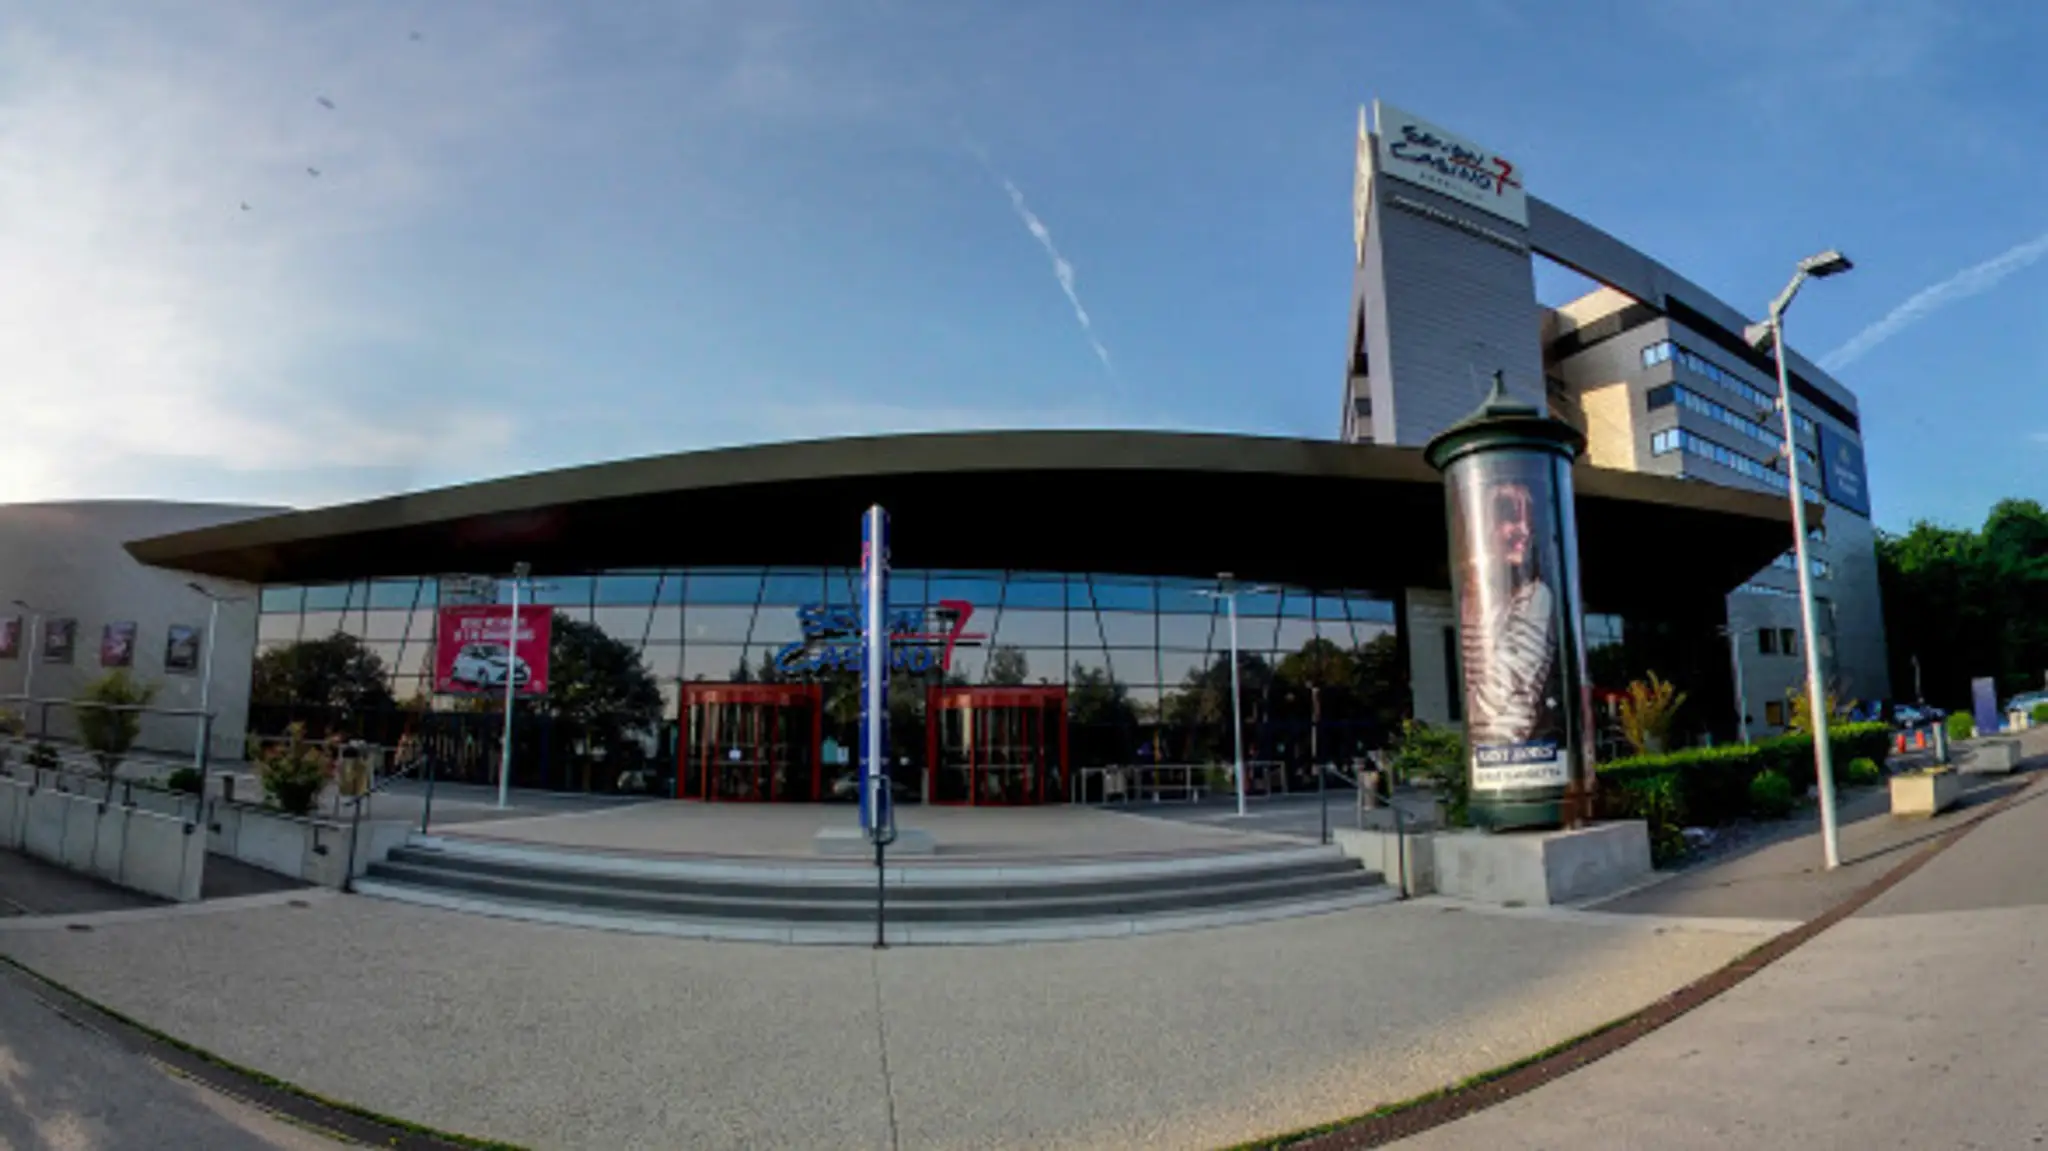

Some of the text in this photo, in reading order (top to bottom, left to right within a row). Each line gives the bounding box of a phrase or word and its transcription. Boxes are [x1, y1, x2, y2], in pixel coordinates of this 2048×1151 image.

[1389, 142, 1492, 190] CASINO
[1492, 156, 1522, 195] 7
[775, 599, 988, 673] CASNO 7
